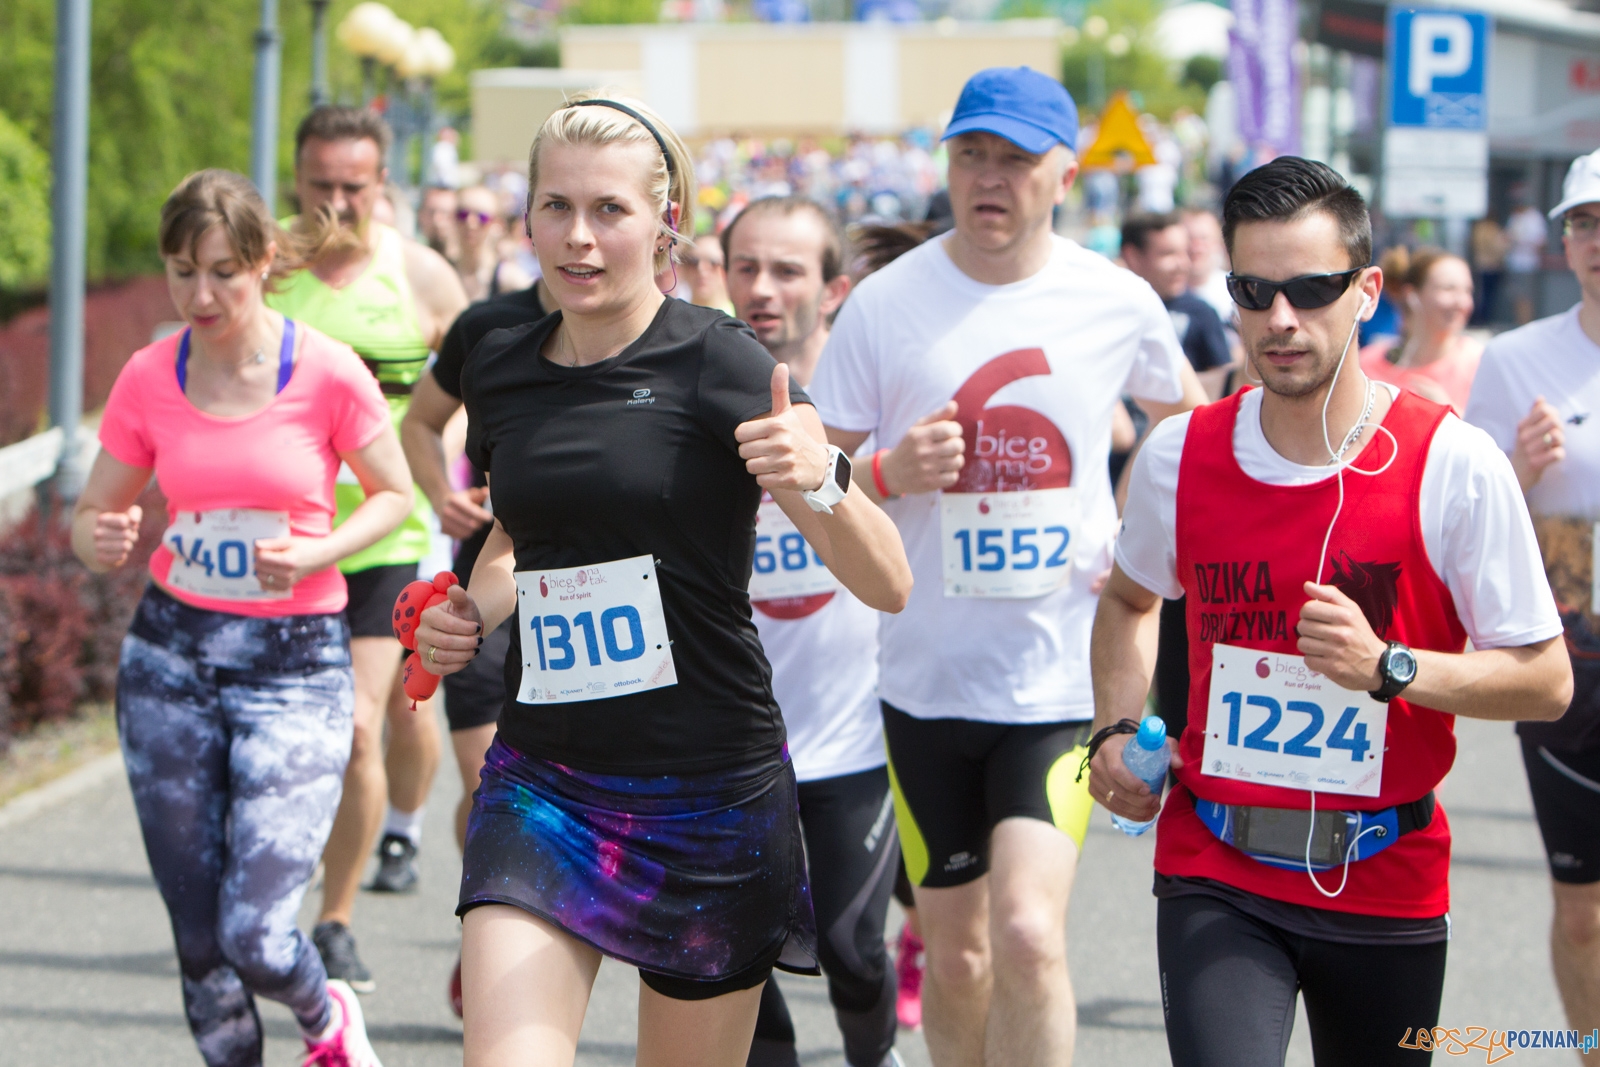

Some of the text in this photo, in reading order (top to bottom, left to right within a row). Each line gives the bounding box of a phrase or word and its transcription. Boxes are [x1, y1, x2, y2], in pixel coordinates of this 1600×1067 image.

[1408, 14, 1474, 97] P
[975, 419, 1052, 474] bieg
[953, 525, 1072, 572] 1552
[549, 573, 576, 594] bieg
[559, 594, 569, 602] Run
[576, 592, 592, 601] Spirit
[1194, 561, 1275, 604] DZIKA
[530, 605, 646, 671] 1310
[1199, 607, 1289, 643] DRUŻYNA
[1275, 657, 1307, 681] bieg
[1284, 681, 1297, 689] Run
[1222, 691, 1371, 762] 1224
